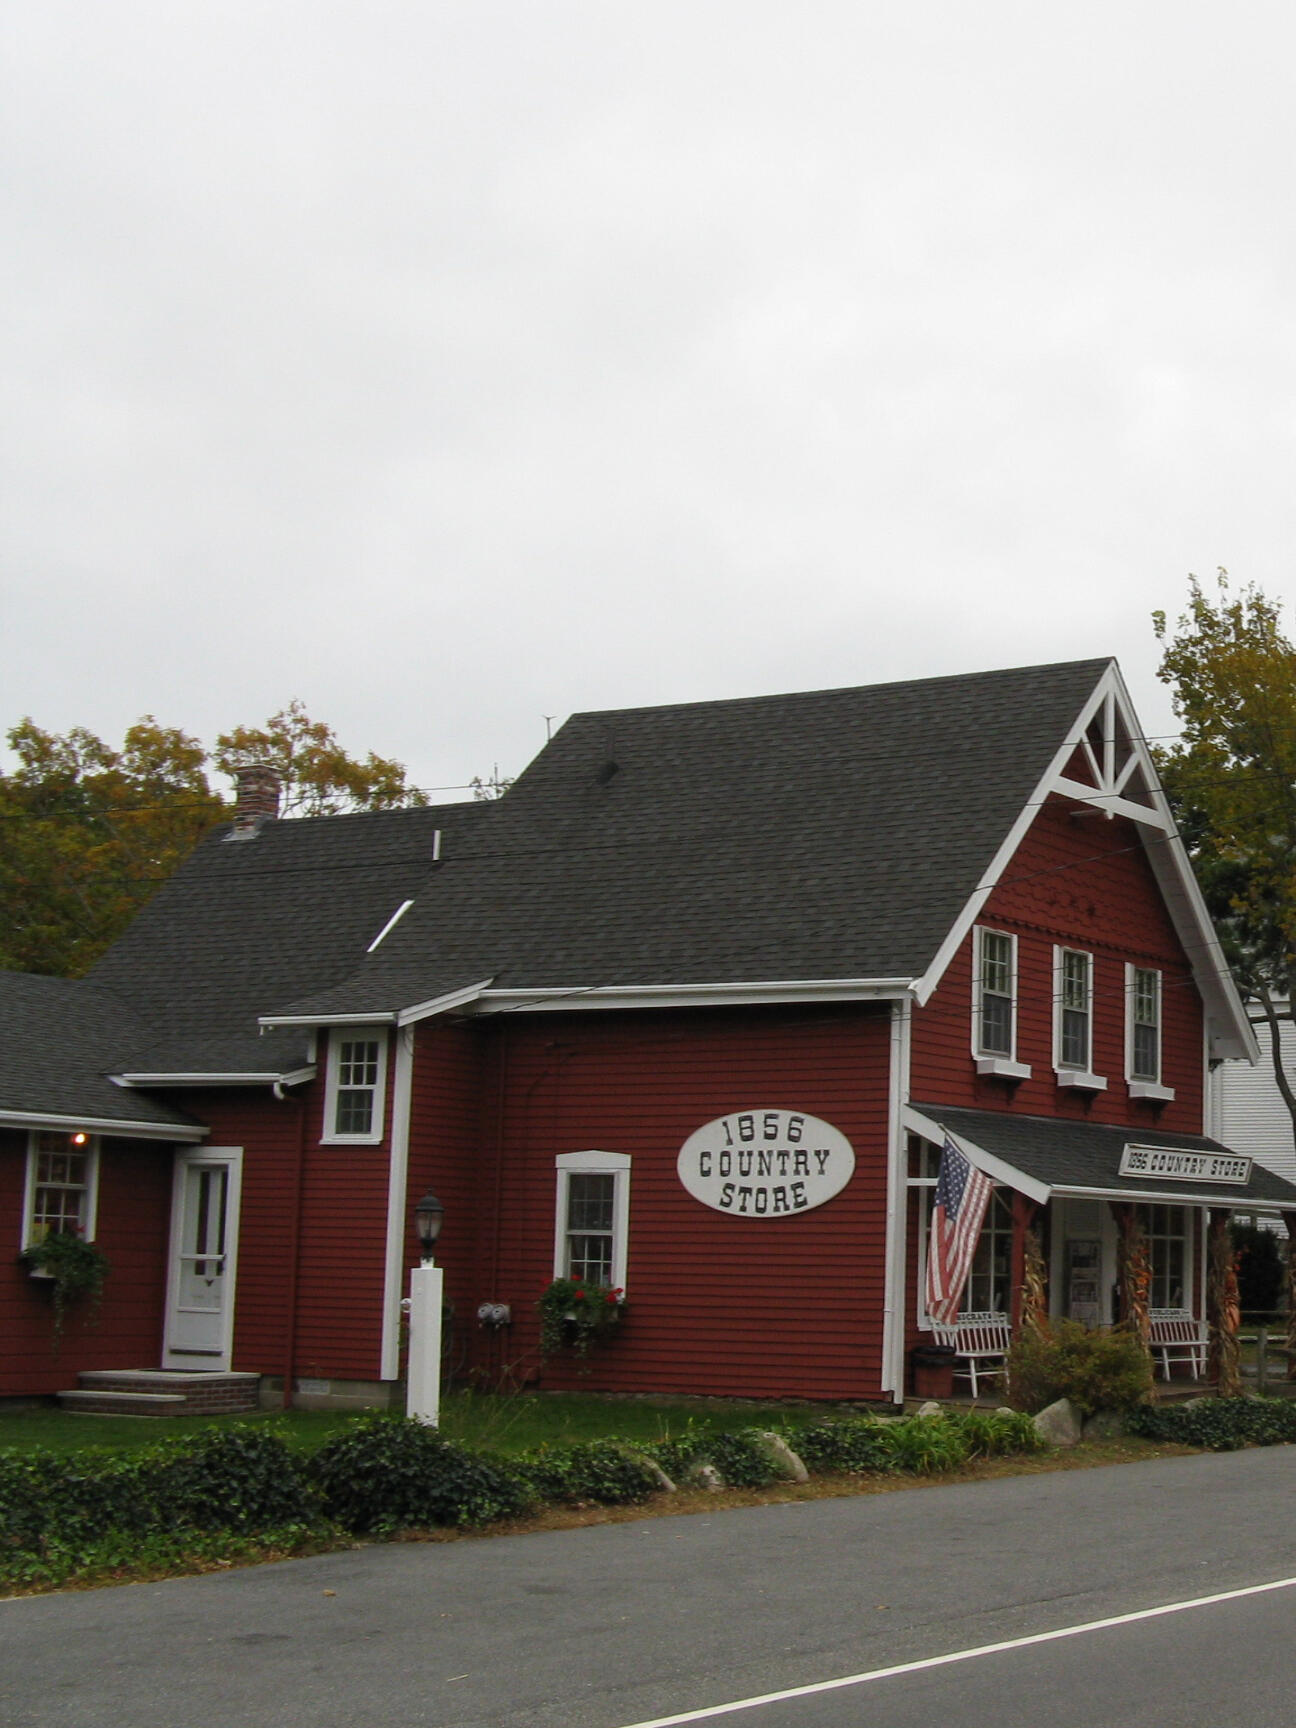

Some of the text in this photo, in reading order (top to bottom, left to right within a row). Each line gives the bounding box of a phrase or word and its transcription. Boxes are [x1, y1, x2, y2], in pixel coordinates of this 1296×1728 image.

[722, 1113, 804, 1146] 1856
[700, 1150, 830, 1177] COUNTRY
[1127, 1151, 1247, 1177] 1856 COUNTRY STORE
[719, 1181, 808, 1214] STORE
